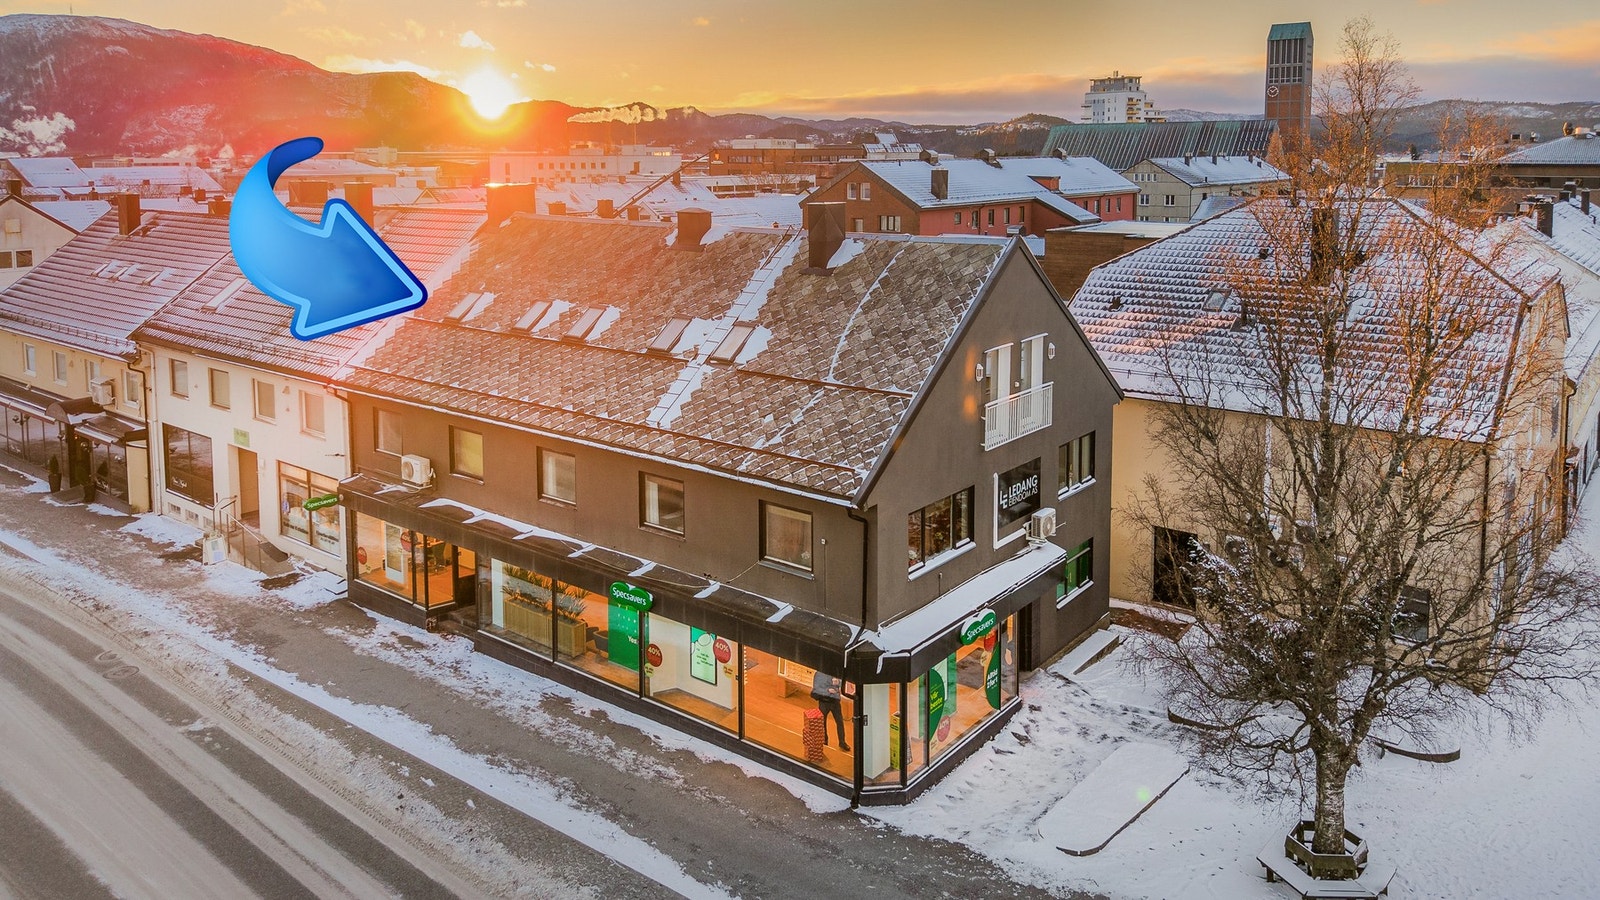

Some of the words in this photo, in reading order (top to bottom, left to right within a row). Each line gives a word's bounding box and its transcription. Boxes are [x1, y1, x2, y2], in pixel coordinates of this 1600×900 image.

[1008, 475, 1038, 498] LEDANG
[1008, 490, 1031, 506] EIENDOM
[1031, 486, 1038, 495] AS
[306, 497, 338, 508] Specsavers
[612, 587, 647, 606] Specsavers
[966, 617, 994, 640] Specsavers
[647, 646, 661, 657] 40%
[715, 642, 729, 653] 40%
